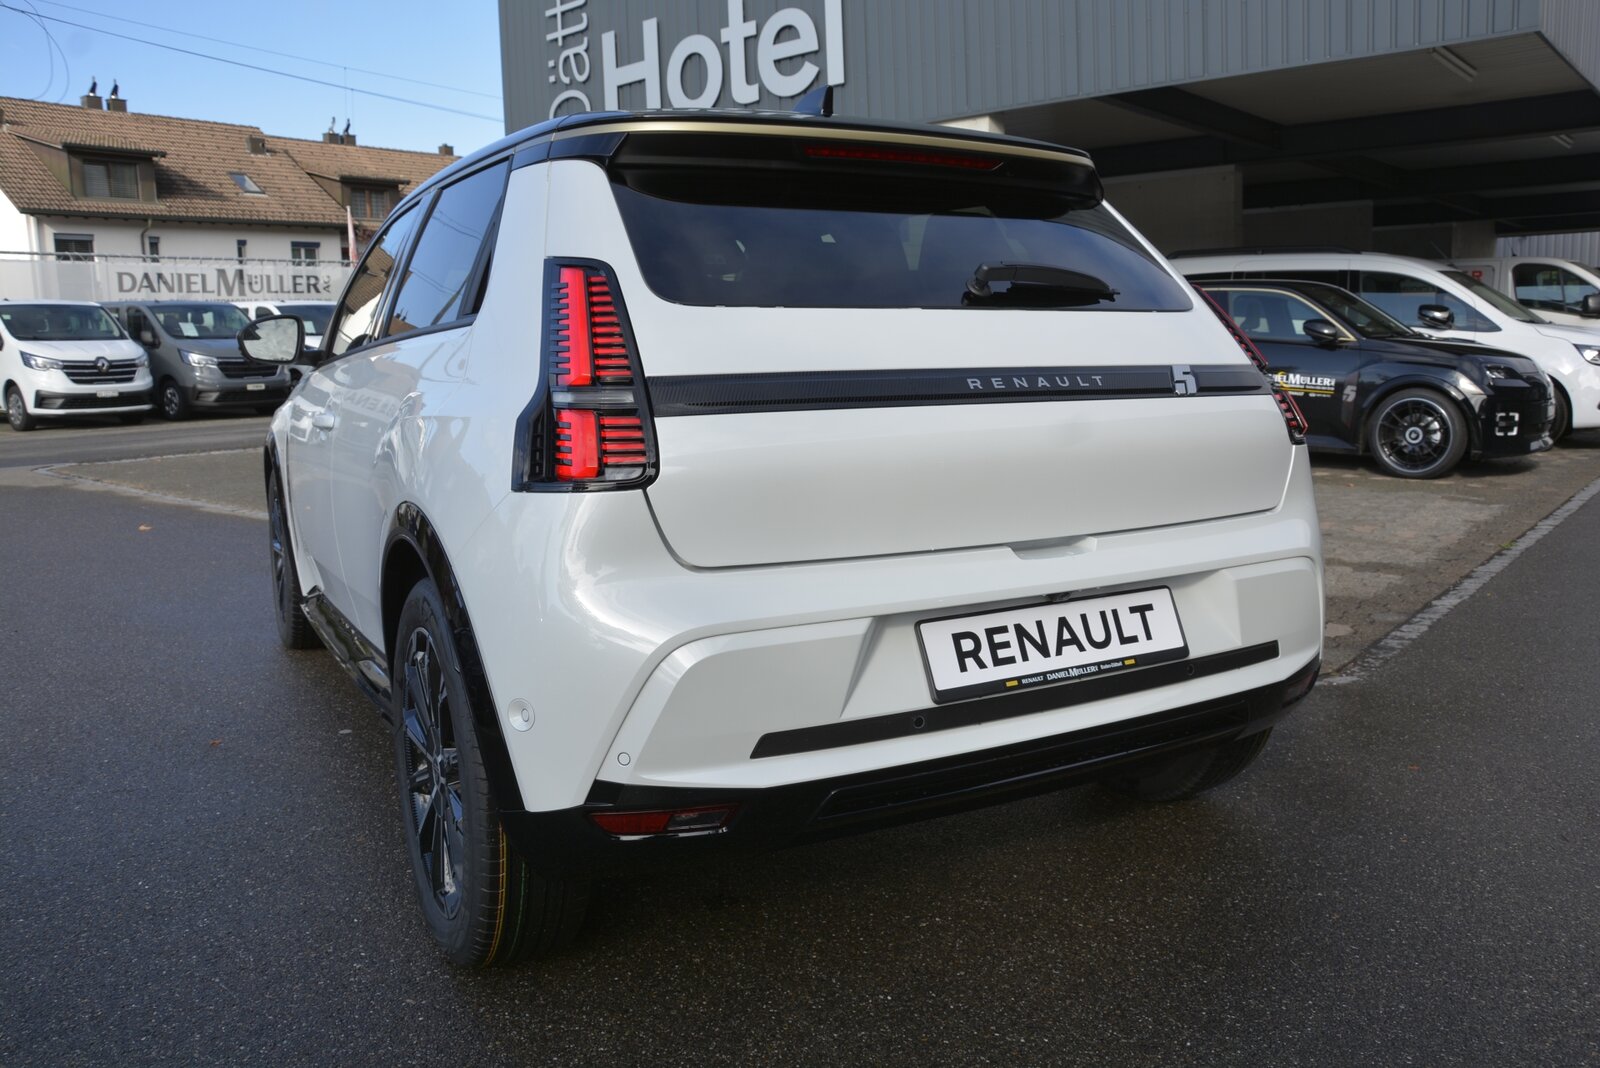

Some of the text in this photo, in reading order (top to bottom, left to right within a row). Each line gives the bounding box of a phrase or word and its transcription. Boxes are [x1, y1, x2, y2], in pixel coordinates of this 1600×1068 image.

[602, 0, 844, 110] Hotel
[966, 375, 1103, 390] RENAULT
[951, 603, 1154, 673] RENAULT
[1021, 675, 1044, 685] RENAULT
